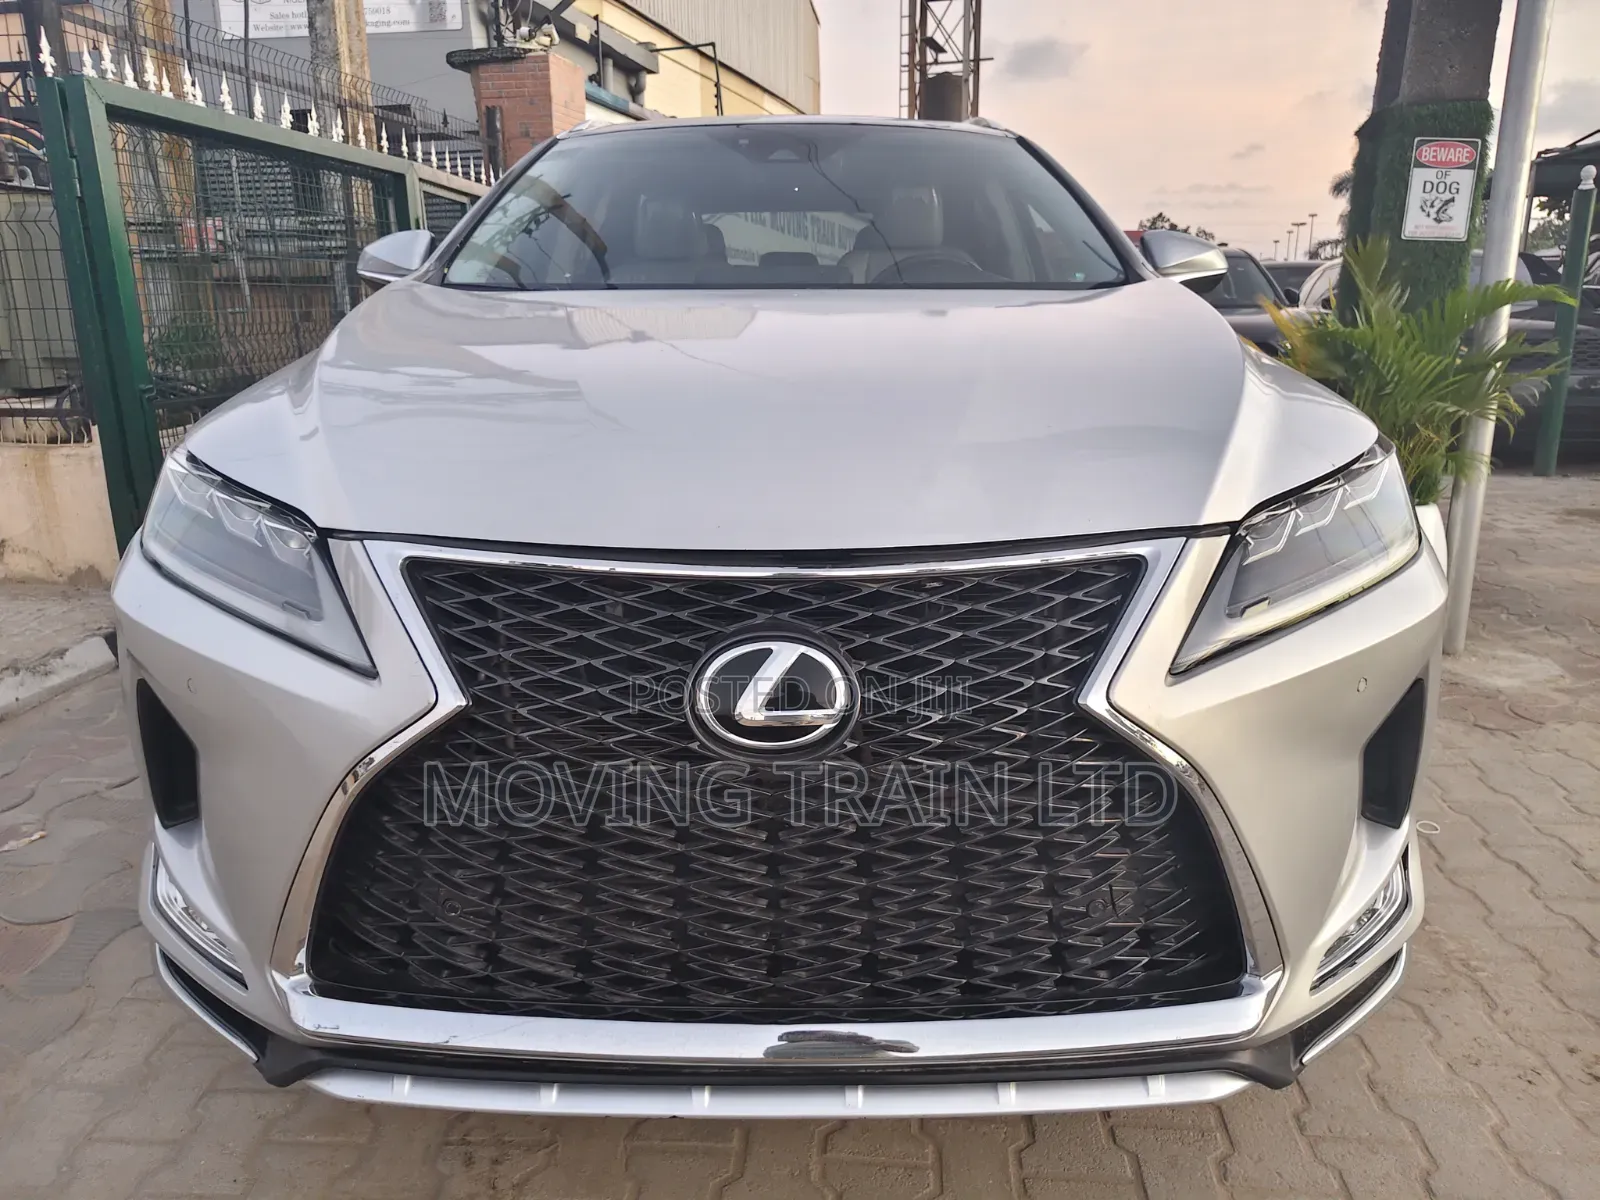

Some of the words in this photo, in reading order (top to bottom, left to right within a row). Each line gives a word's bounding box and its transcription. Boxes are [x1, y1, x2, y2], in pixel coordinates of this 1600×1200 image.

[291, 10, 308, 19] hotl
[1421, 147, 1471, 162] BEWARE
[1436, 170, 1451, 180] OF
[1422, 180, 1460, 195] DOG
